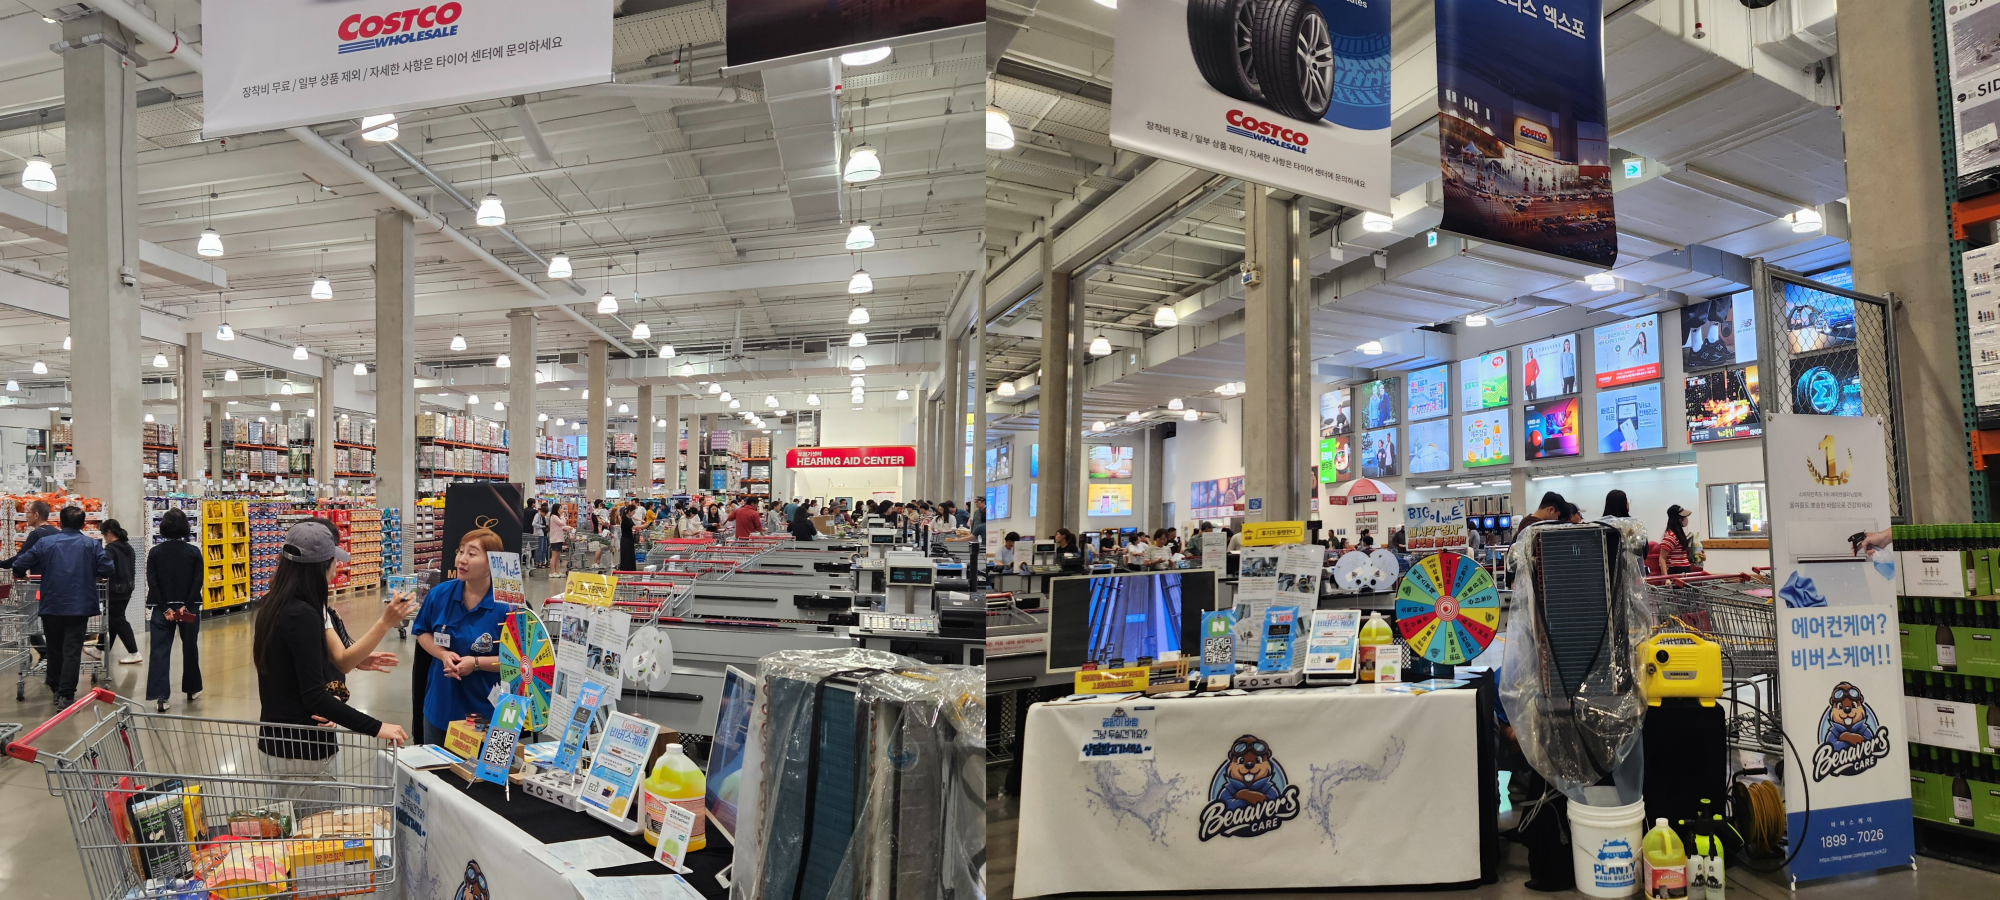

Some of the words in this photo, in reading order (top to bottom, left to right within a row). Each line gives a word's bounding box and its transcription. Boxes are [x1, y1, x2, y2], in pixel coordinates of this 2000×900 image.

[338, 1, 462, 41] COSTCO
[1543, 5, 1585, 39] 엑스포
[374, 25, 458, 49] WHOLESALE
[242, 83, 270, 98] 장착비
[271, 79, 291, 94] 무료
[298, 76, 317, 90] 일부
[319, 71, 340, 88] 상품
[341, 68, 361, 83] 제외
[369, 62, 400, 78] 자세한
[402, 57, 434, 73] 사항은
[436, 52, 468, 68] 타이어
[470, 46, 503, 63] 센터에
[506, 37, 562, 57] 문의하세요
[1226, 109, 1309, 146] COSTCO
[1520, 125, 1547, 140] COSTCO
[1250, 133, 1307, 154] WHOLESALE
[1146, 120, 1171, 136] 장착비
[1173, 128, 1188, 140] 무료
[1195, 134, 1211, 145] 일부
[1212, 138, 1227, 151] 상품
[1229, 144, 1244, 155] 제외
[1249, 150, 1271, 163] 자세한
[1272, 156, 1293, 169] 사항은
[1293, 161, 1314, 175] 타이어
[1315, 167, 1334, 180] 센터에
[1334, 173, 1366, 188] 문의하세요
[797, 457, 841, 466] HEARING
[843, 457, 860, 465] AID
[863, 456, 904, 465] CENTER
[1408, 506, 1430, 519] BIG
[1430, 505, 1463, 524] 이벤트
[1408, 527, 1417, 538] 매
[1418, 526, 1436, 537] 시각
[491, 556, 503, 568] BIG
[1212, 621, 1225, 632] N
[1791, 613, 1887, 639] 에어컨케어?
[1791, 644, 1891, 671] 비버스케어!!
[502, 708, 517, 723] N
[1125, 717, 1138, 727] 바람
[610, 727, 648, 748] 비버스케어
[1092, 730, 1107, 740] 그냥
[1854, 758, 1875, 771] CARE
[588, 783, 598, 793] ECO
[1251, 818, 1279, 832] CARE
[1820, 833, 1847, 848] 1899
[1857, 828, 1884, 843] 7026
